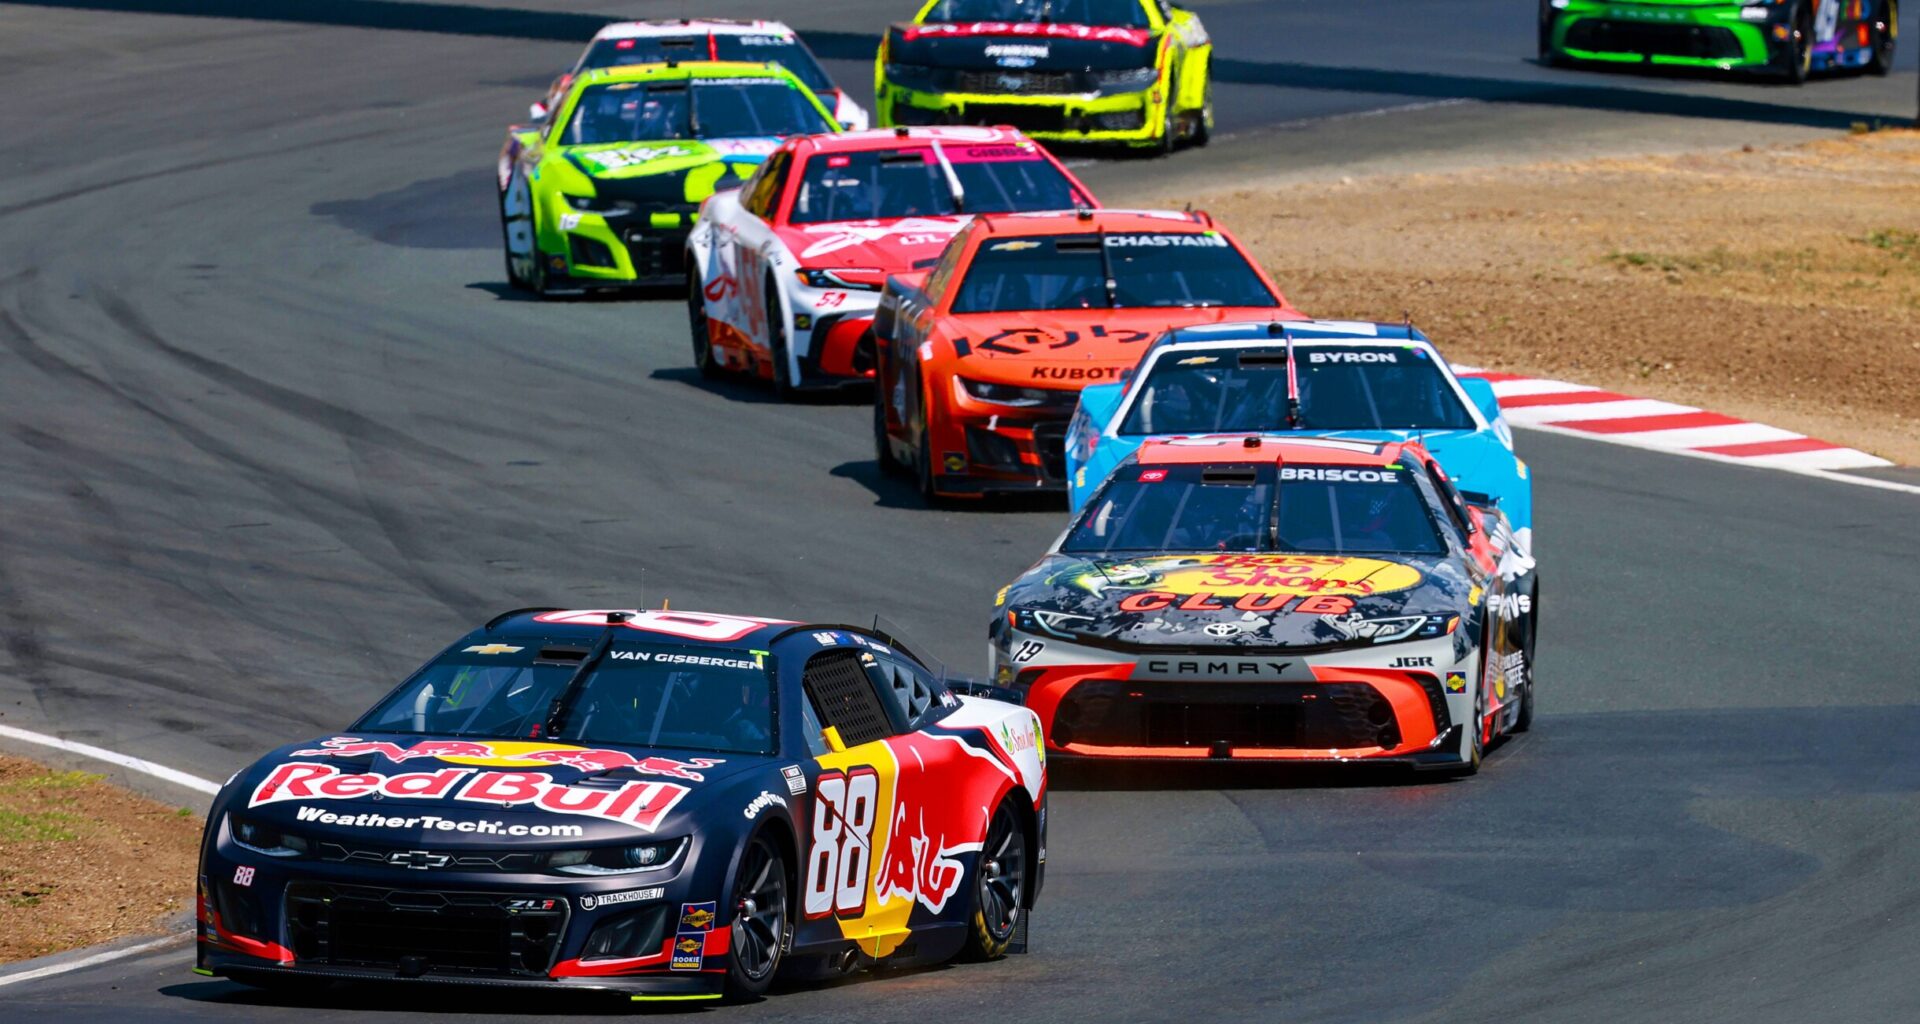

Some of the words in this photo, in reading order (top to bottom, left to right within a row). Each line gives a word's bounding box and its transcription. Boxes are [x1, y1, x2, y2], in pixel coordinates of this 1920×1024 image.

[1104, 235, 1228, 248] CHASTAIN
[1309, 353, 1397, 363] BYRON
[1031, 366, 1120, 380] KUBOT
[987, 414, 998, 431] 1
[1281, 468, 1399, 482] BRISCOE
[1200, 572, 1375, 593] Shops
[1118, 591, 1358, 615] CLUB
[1012, 639, 1046, 663] 19
[610, 651, 651, 661] VAN
[654, 653, 764, 670] GISBERGEN
[1149, 660, 1293, 675] CAMRY
[1389, 656, 1435, 668] JGR
[248, 762, 478, 809] Red
[454, 770, 692, 833] Bull
[804, 768, 879, 920] 88
[233, 865, 256, 887] 88
[601, 888, 655, 905] TRACKHOUSE
